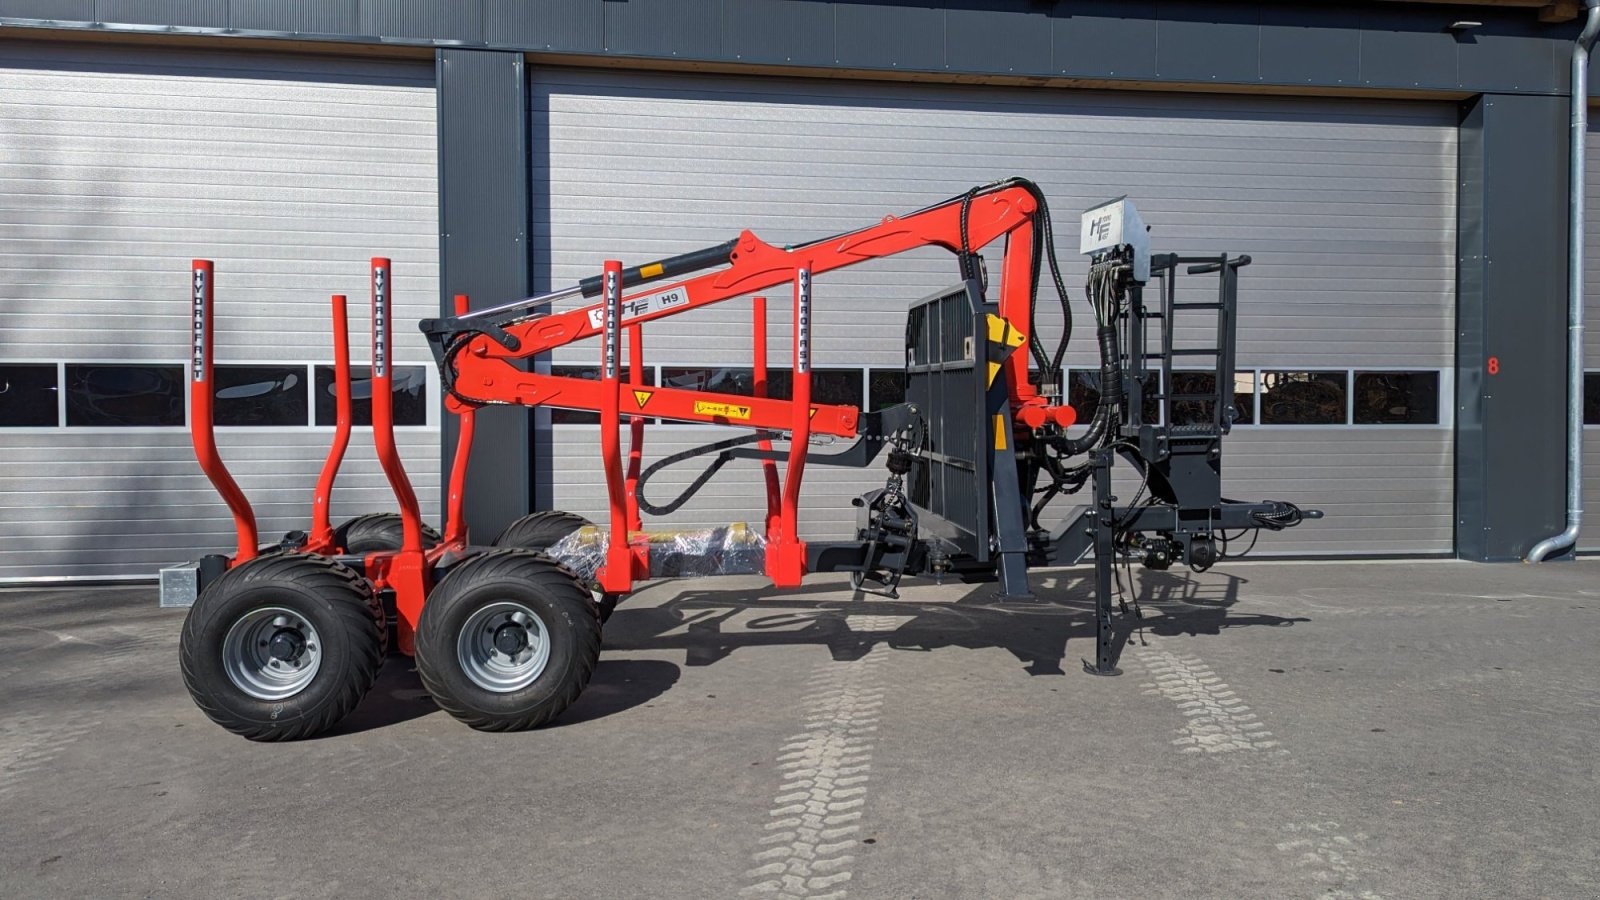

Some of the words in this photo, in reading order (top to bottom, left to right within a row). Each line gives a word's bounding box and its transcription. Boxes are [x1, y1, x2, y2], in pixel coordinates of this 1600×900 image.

[193, 272, 203, 379] HYDROFAST
[374, 270, 384, 374] HYDROFAST
[606, 274, 616, 376] HYDROFAST
[661, 293, 679, 305] H9
[799, 271, 809, 370] HYDROFAST
[1488, 356, 1499, 375] 8
